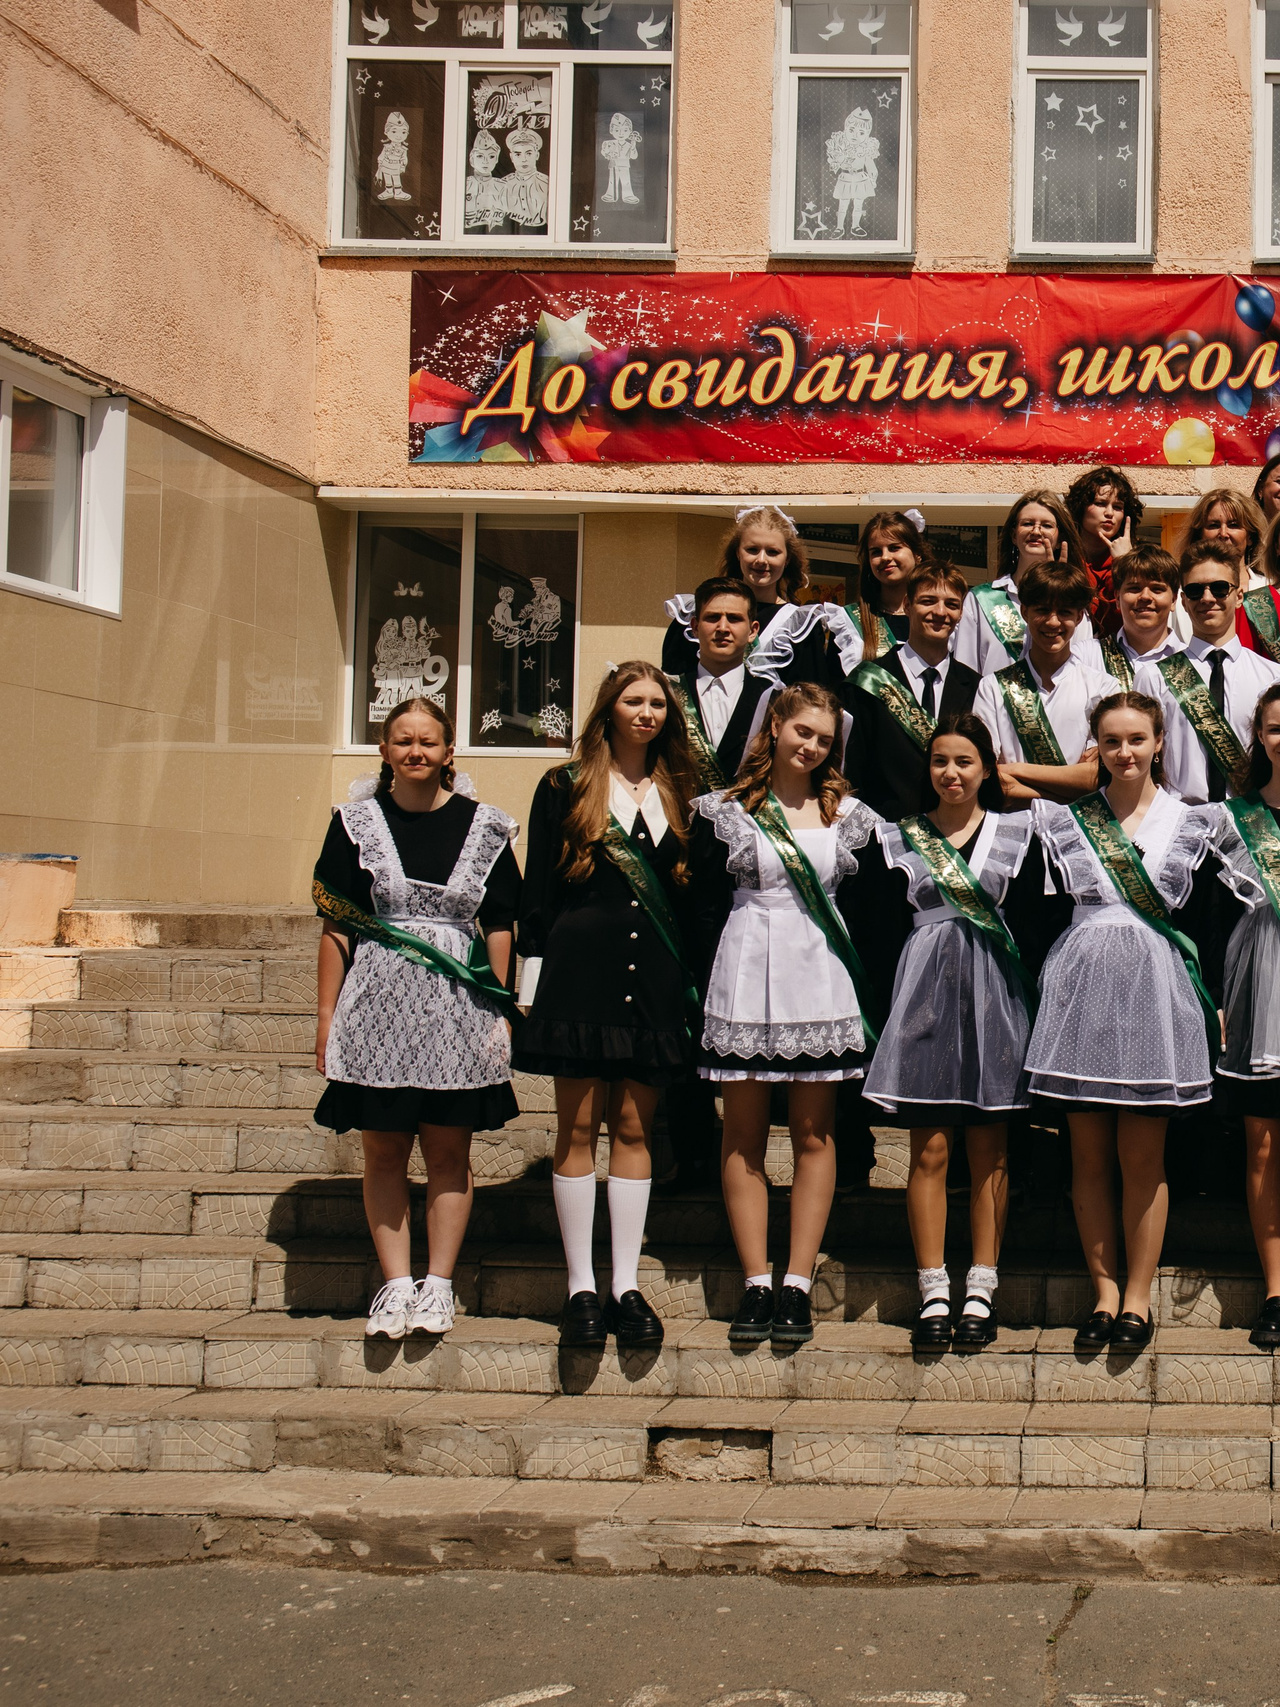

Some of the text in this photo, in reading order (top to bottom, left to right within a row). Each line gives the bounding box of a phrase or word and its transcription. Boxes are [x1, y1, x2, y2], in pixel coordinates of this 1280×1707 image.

[520, 5, 568, 39] 1945
[460, 341, 585, 437] До
[609, 325, 1029, 408] свидания,
[422, 655, 450, 695] 9
